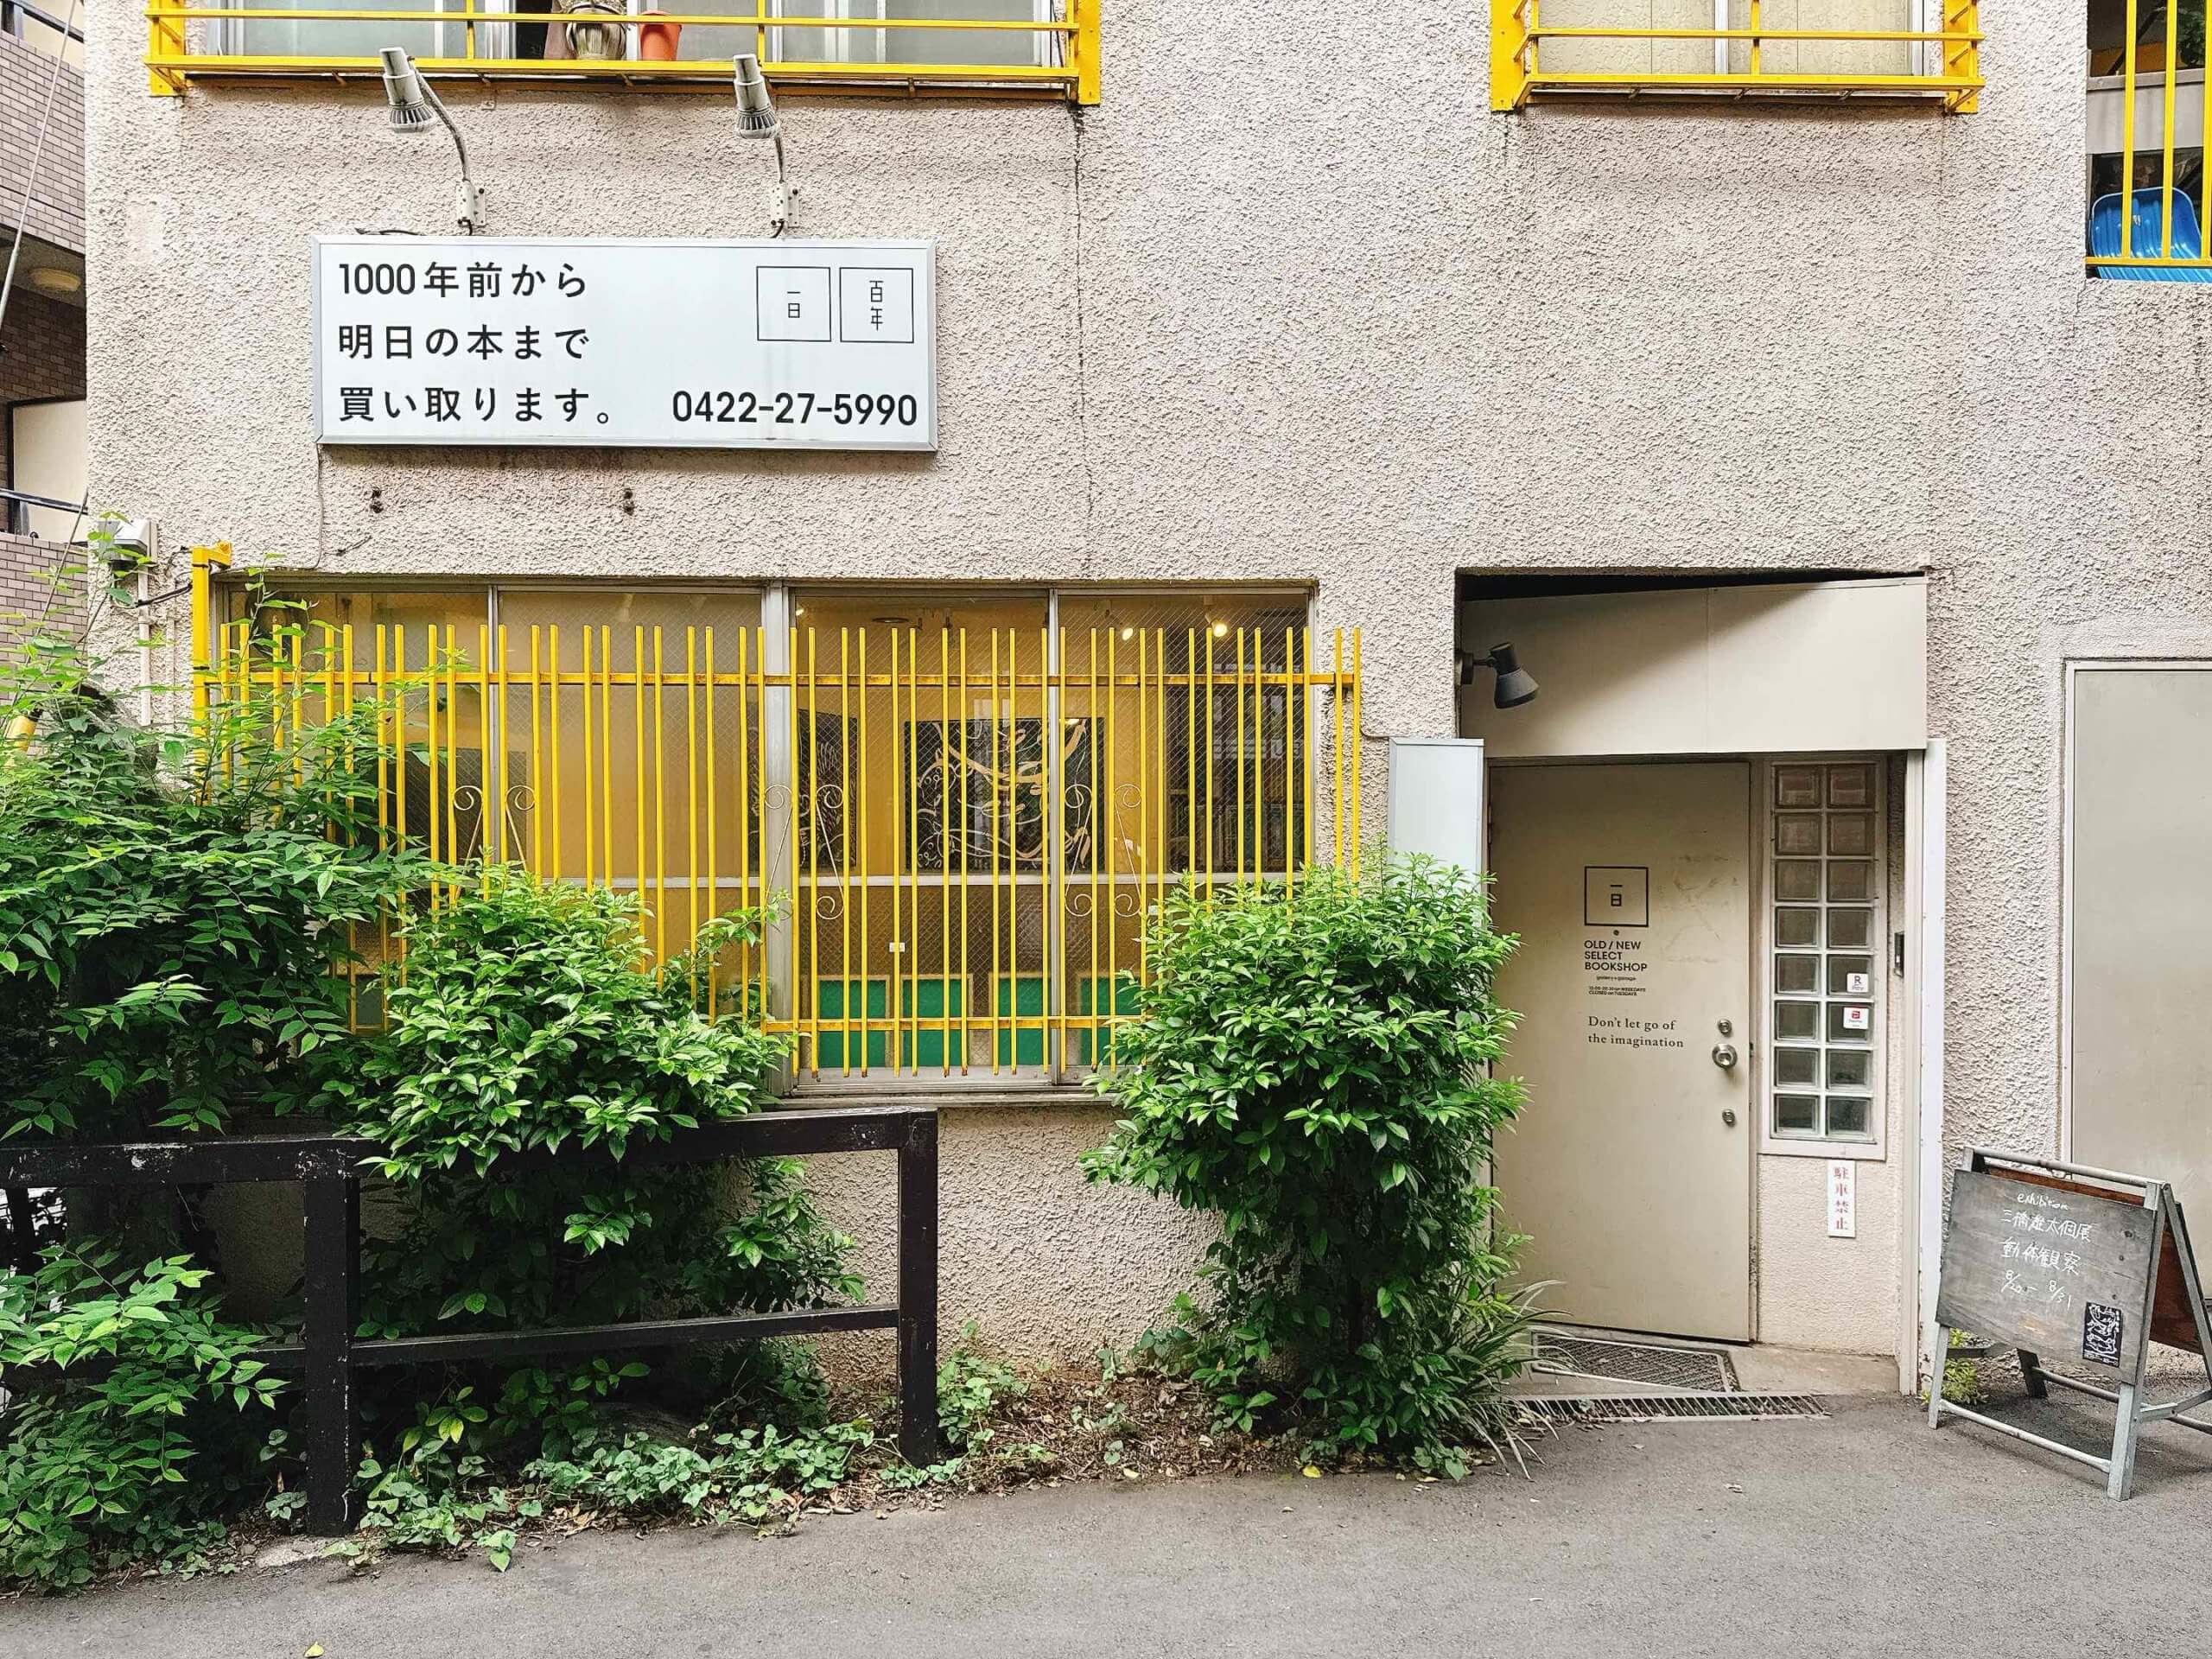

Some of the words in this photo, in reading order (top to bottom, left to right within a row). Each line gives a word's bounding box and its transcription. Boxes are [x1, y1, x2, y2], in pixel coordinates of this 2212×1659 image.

[339, 261, 585, 298] 1000年前から
[787, 291, 800, 319] 一日
[869, 280, 883, 331] 百年
[339, 323, 589, 360] 明日の本まで
[340, 386, 609, 424] 買い取ります。
[672, 391, 917, 426] 0422-27-5990
[1584, 940, 1606, 950] OLD
[1616, 941, 1641, 950] NEW
[1584, 951, 1623, 960] SELECT
[1585, 962, 1648, 972] BOOKSHOP
[1588, 1033, 1608, 1044] the
[1611, 1034, 1684, 1049] imagination
[1624, 1018, 1641, 1028] let
[1644, 1021, 1659, 1033] go
[1662, 1020, 1677, 1030] of
[1834, 1166, 1849, 1230] 駐車禁止
